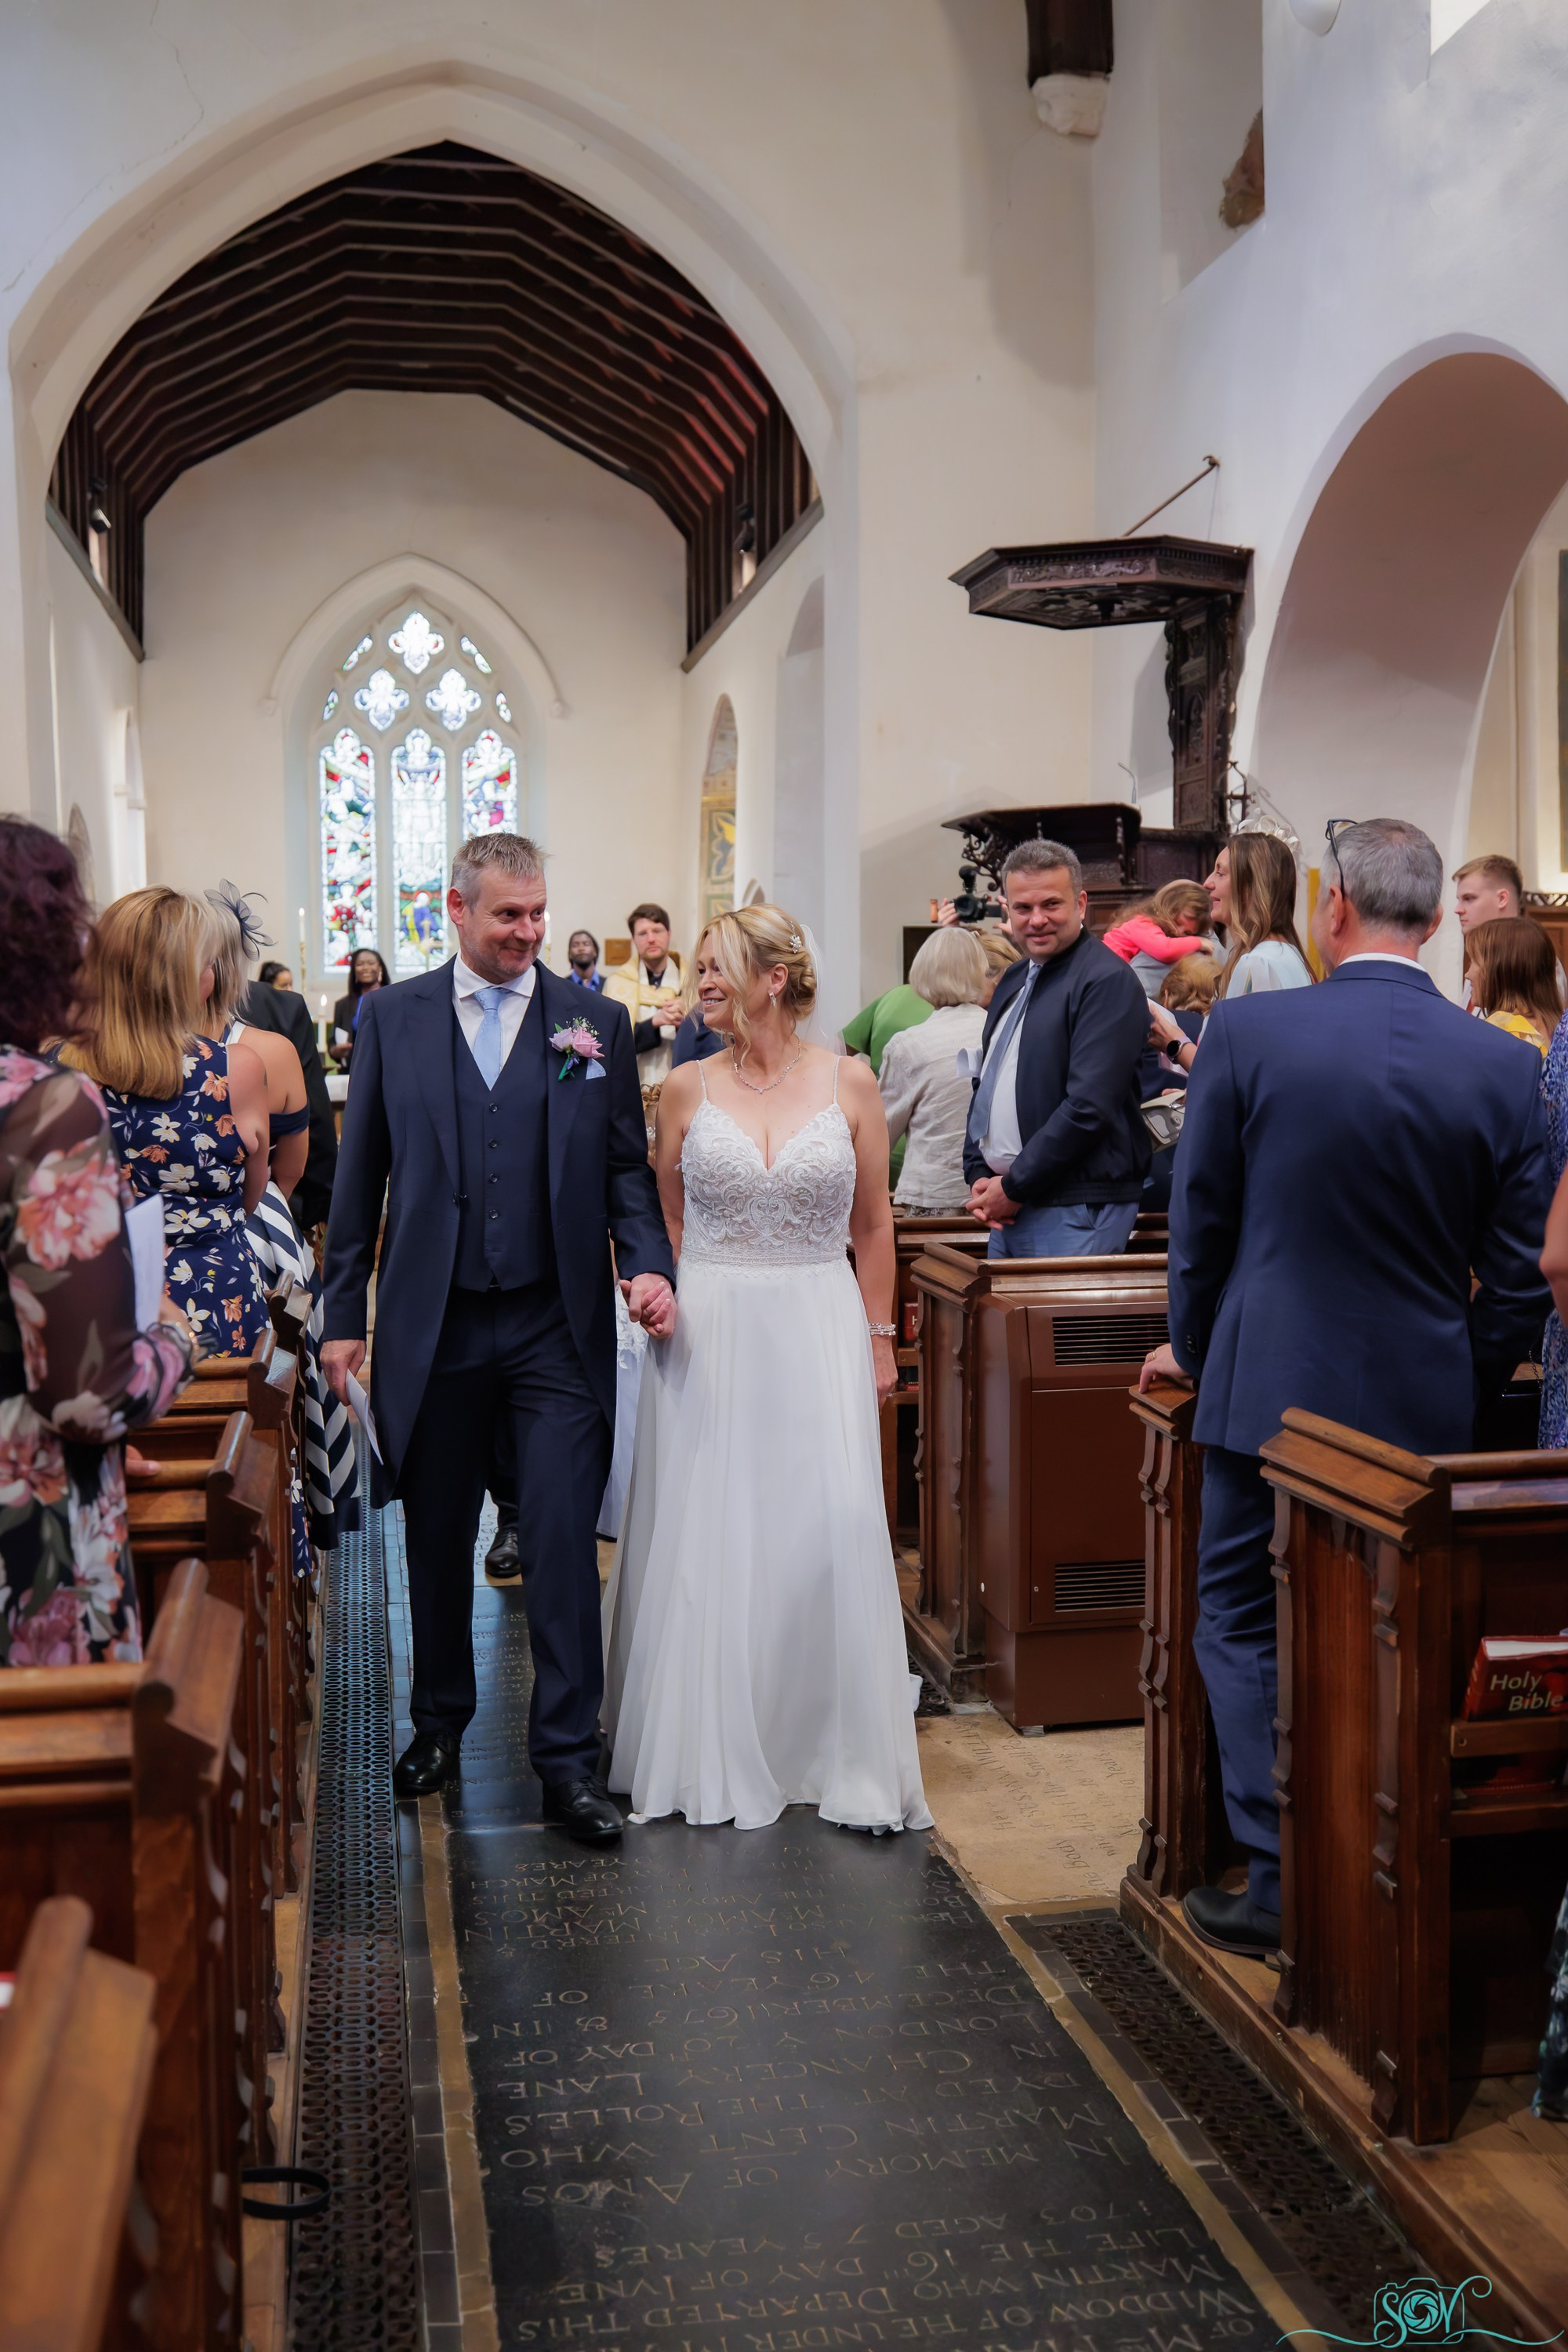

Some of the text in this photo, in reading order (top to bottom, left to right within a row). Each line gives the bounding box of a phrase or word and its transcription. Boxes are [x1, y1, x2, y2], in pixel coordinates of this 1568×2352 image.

[1490, 1671, 1542, 1693] Holy
[1508, 1690, 1563, 1711] Bible
[470, 1875, 575, 1889] MARCH
[474, 1904, 593, 1926] AMOS
[464, 1917, 640, 1943] MARTIN
[760, 1947, 846, 1963] HIS
[902, 1960, 1005, 1979] THE
[534, 1990, 588, 2006] OF
[771, 1985, 1019, 2016] DECEMBER
[492, 2020, 543, 2038] IN
[834, 2011, 1043, 2042] LONDON
[504, 2049, 558, 2067] OF
[576, 2041, 655, 2062] DAY
[497, 2040, 1059, 2099] IN CHANCERY LANE
[504, 2073, 1081, 2136] DYED AT THE ROLLES
[884, 2103, 1105, 2137] MARTIN
[500, 2141, 659, 2168] WHO
[521, 2136, 1131, 2206] IN MEMORY OF AMOS
[895, 2212, 1007, 2238] AGED
[1040, 2200, 1151, 2226] 1703
[594, 2236, 784, 2268] YEARES
[981, 2238, 1071, 2262] THE
[1086, 2227, 1199, 2252] LIFE
[690, 2268, 749, 2291] OF
[768, 2256, 863, 2284] DAY
[517, 2253, 1225, 2341] MARTIN WHO DEPARTED THIS
[1049, 2288, 1254, 2322] WIDDOW
[891, 2314, 967, 2338] THE
[976, 2305, 1034, 2330] OF
[1210, 2318, 1254, 2338] OF
[742, 2322, 884, 2351] UNDER
